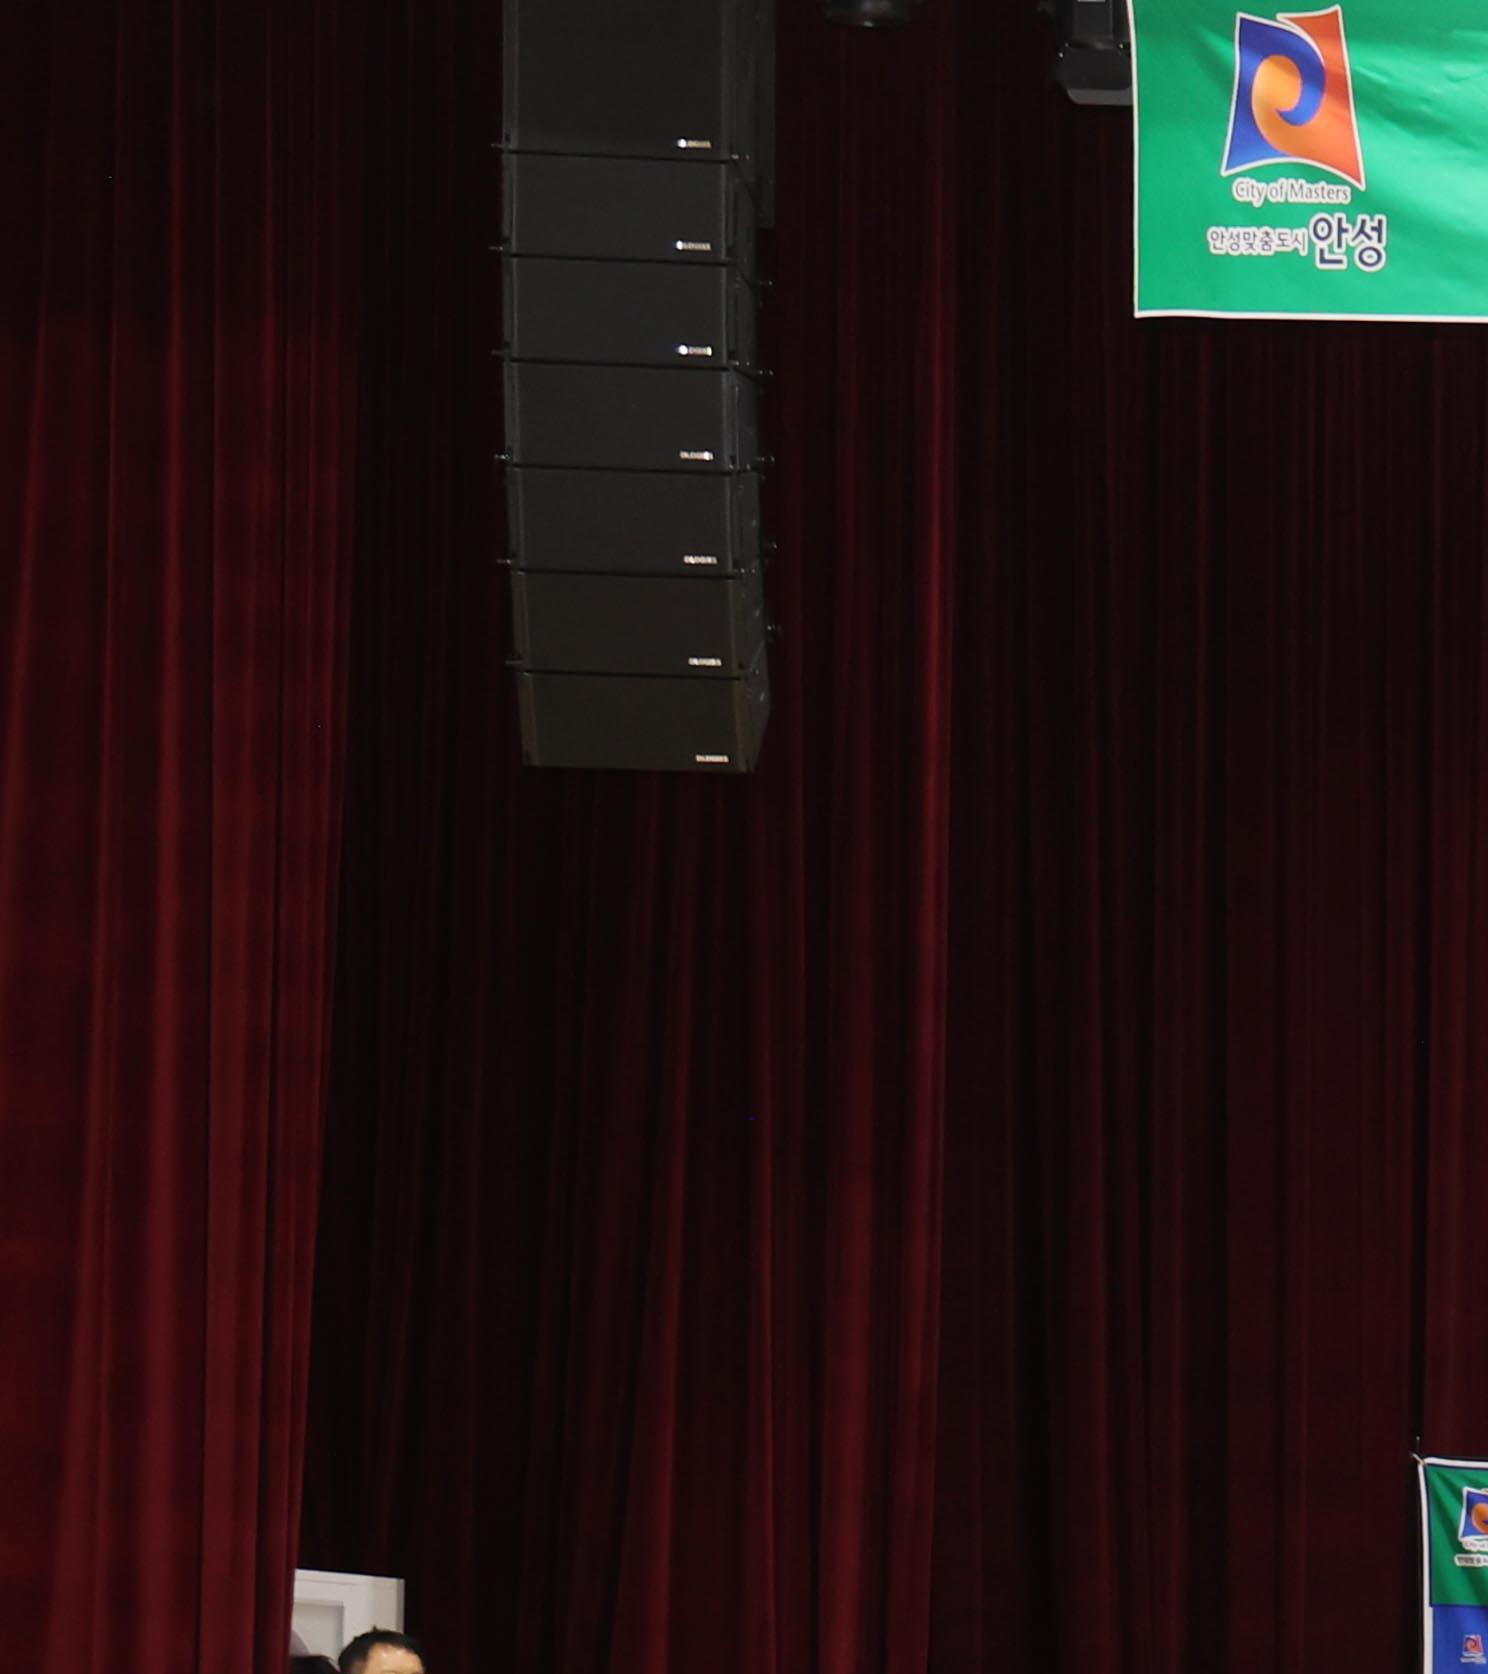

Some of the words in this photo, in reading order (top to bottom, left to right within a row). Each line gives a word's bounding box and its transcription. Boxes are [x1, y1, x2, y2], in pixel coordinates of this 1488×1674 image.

[1235, 179, 1266, 205] City
[1269, 178, 1285, 198] of
[1289, 182, 1349, 201] Masters
[1209, 229, 1307, 252] 안성맞춤도시
[1312, 216, 1385, 268] 안성
